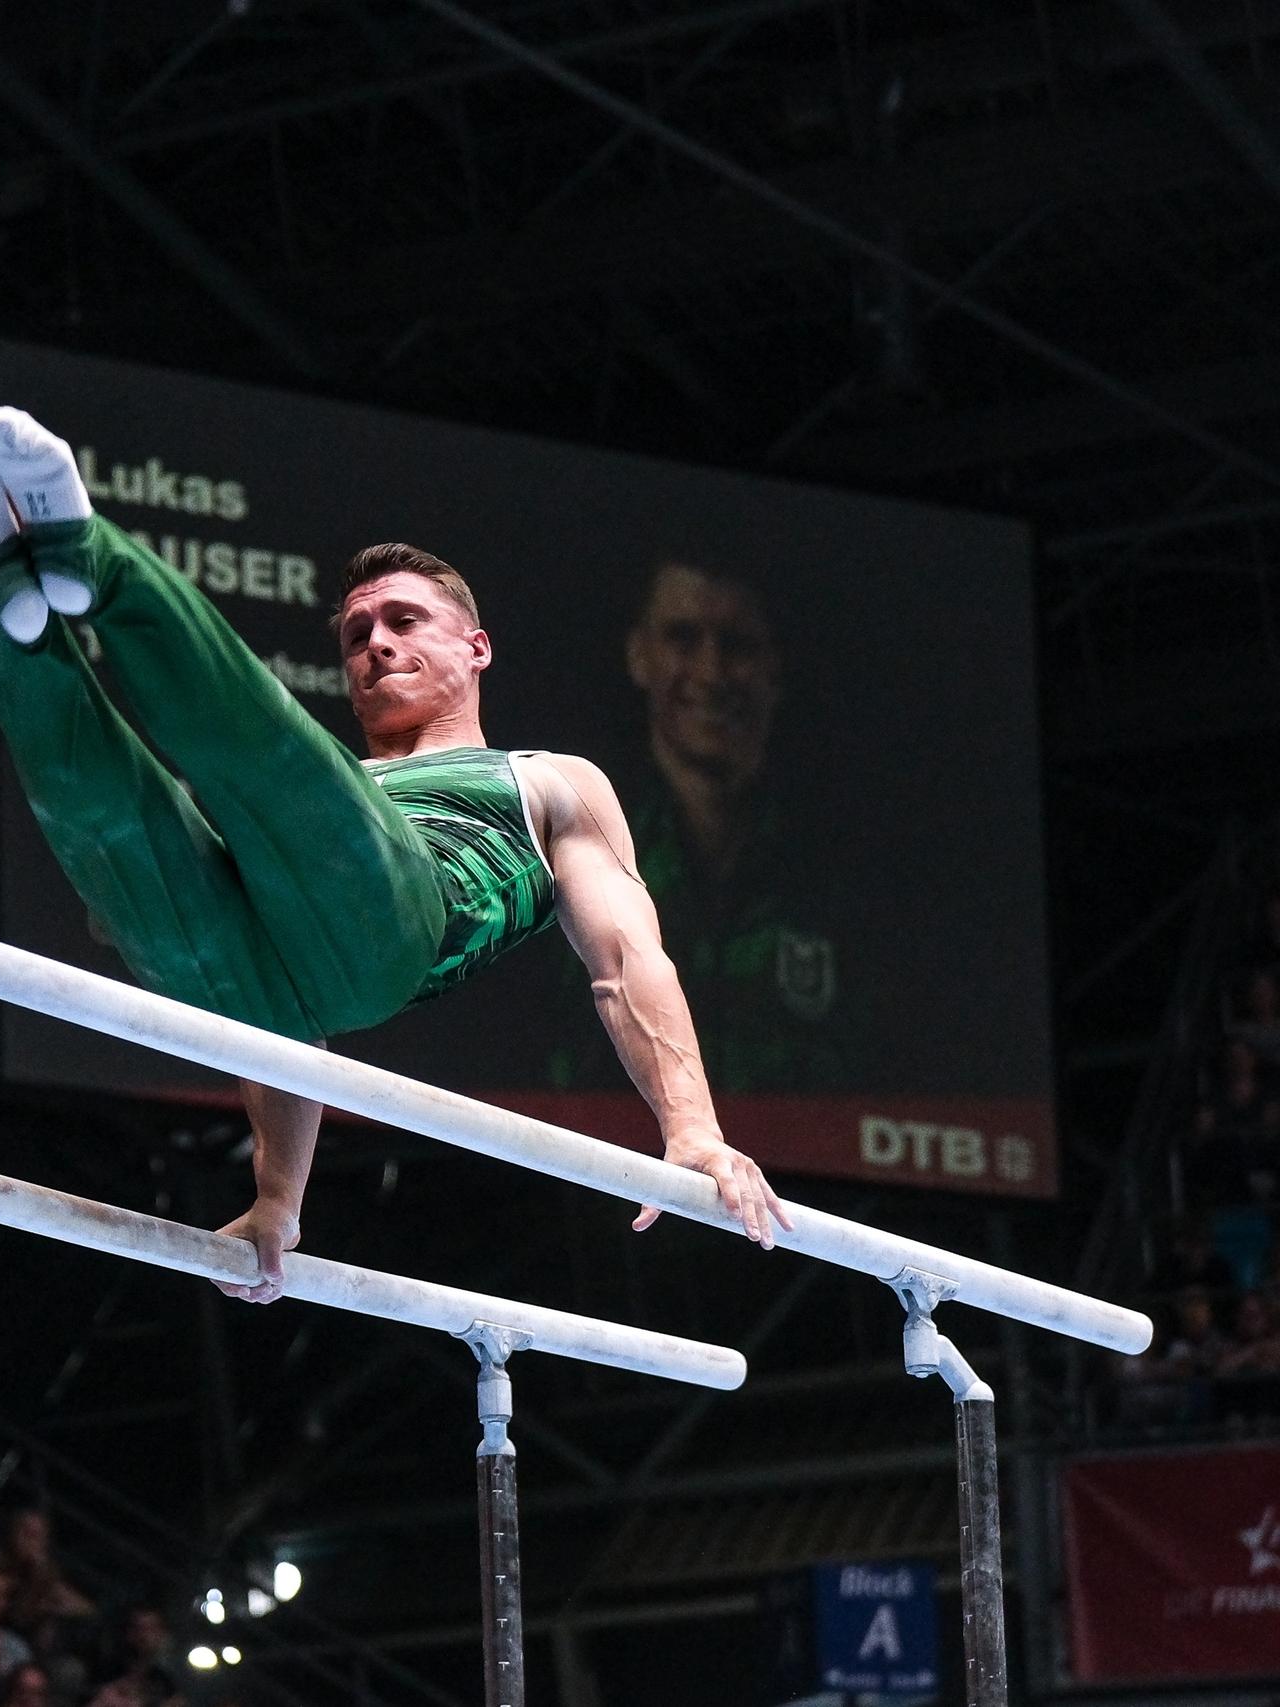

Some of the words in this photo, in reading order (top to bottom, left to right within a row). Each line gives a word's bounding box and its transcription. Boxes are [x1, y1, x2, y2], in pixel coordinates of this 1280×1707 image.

[76, 446, 248, 521] Lukas
[860, 1114, 986, 1177] DTB
[840, 1566, 913, 1597] Block
[859, 1603, 902, 1659] A
